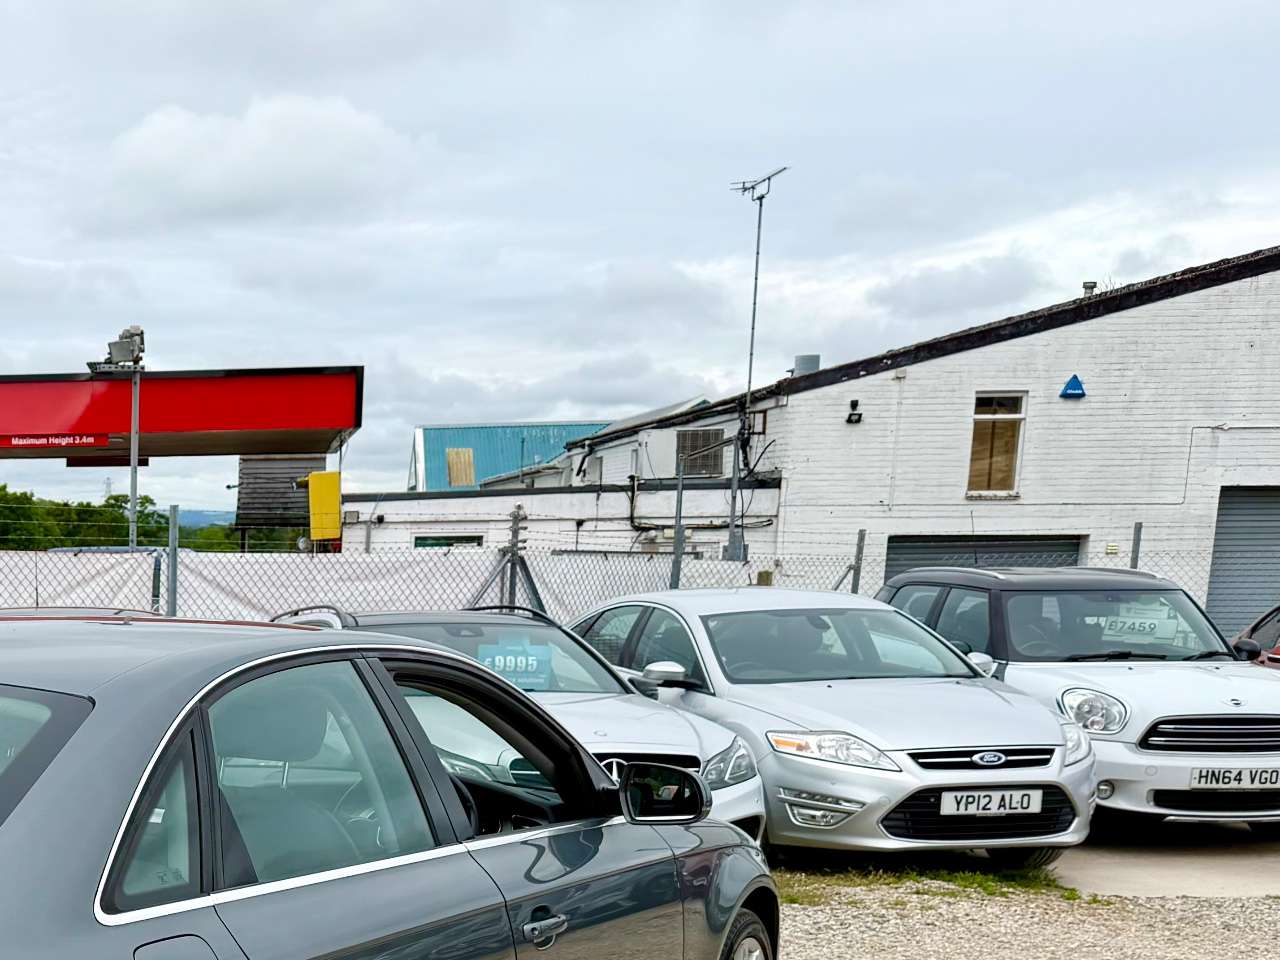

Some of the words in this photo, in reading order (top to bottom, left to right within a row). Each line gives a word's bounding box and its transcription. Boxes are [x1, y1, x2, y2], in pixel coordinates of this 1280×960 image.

[12, 436, 47, 445] Maximum
[48, 436, 74, 446] Height
[74, 435, 94, 444] 3.4m
[1198, 769, 1243, 785] HN64
[1249, 769, 1280, 785] VGO
[954, 794, 992, 811] YP12
[997, 793, 1031, 810] ALO
